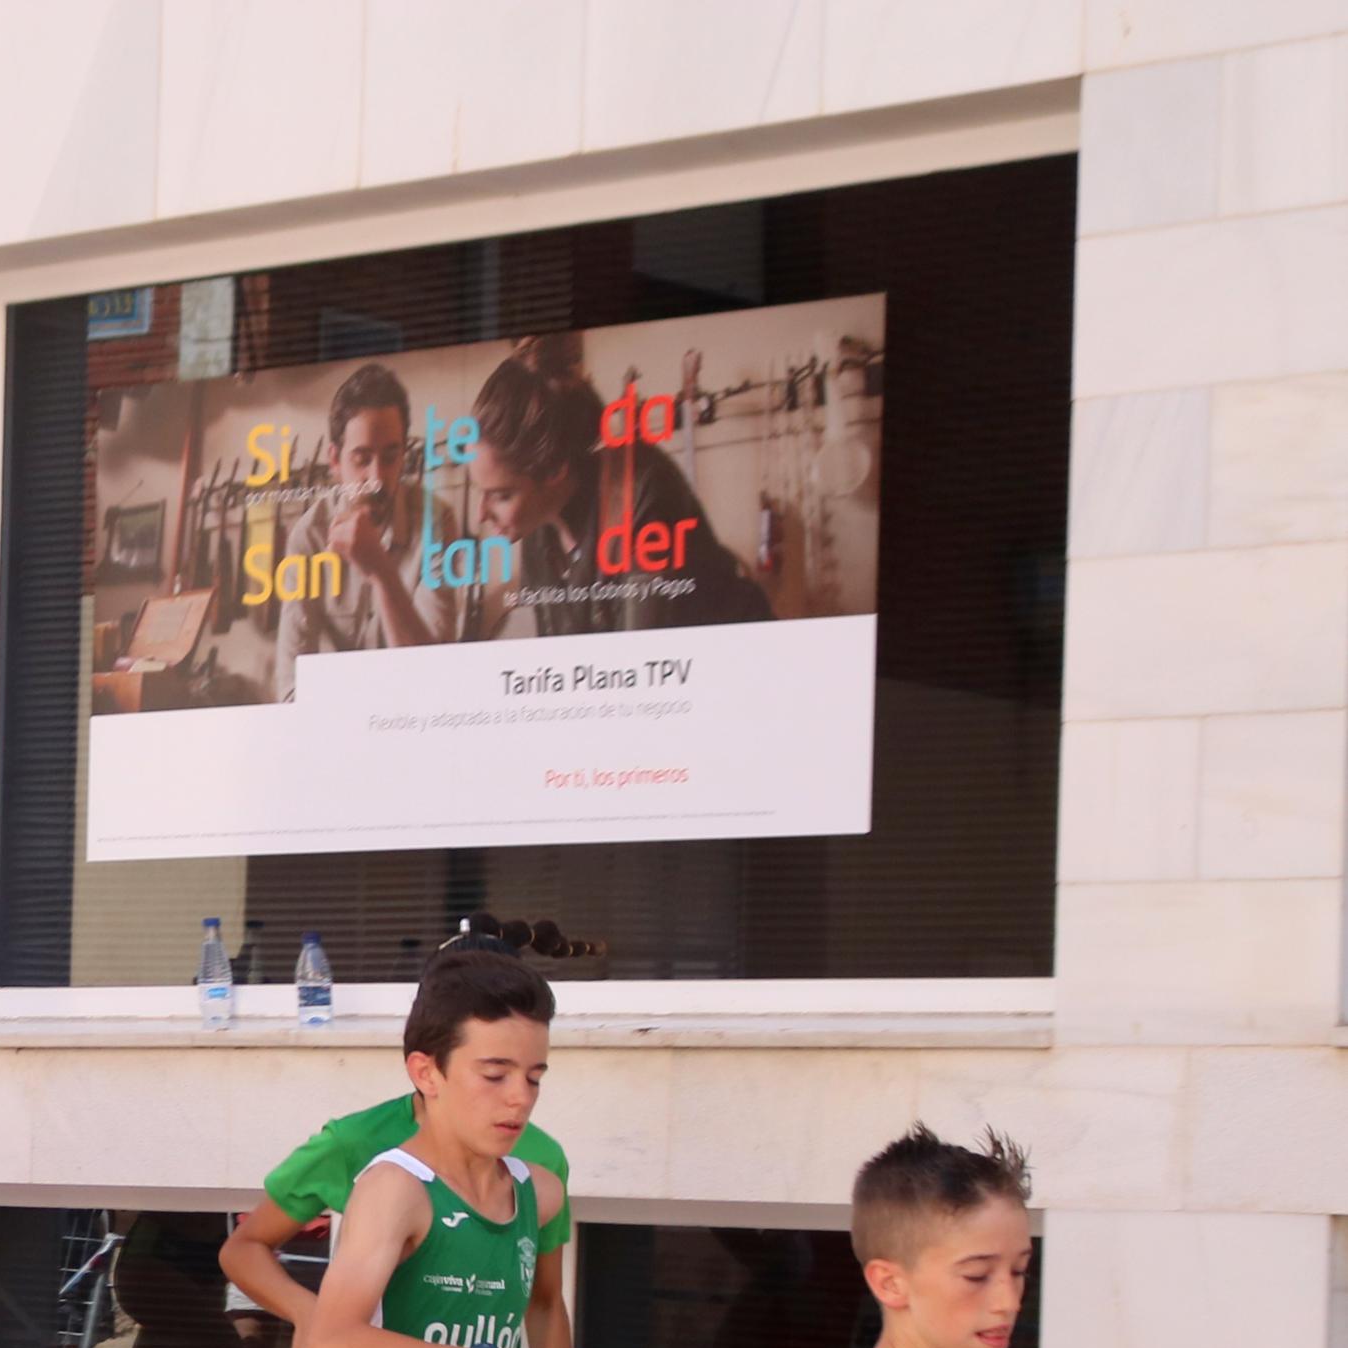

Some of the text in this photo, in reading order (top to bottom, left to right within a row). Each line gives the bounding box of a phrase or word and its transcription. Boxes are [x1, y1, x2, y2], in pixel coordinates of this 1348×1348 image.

[244, 383, 675, 487] Si te da
[241, 510, 699, 605] San tan der
[650, 576, 697, 600] Pagos
[501, 658, 693, 697] Tarifa Plana TPV
[544, 768, 571, 789] Por
[592, 766, 614, 787] los
[617, 766, 690, 790] primeros
